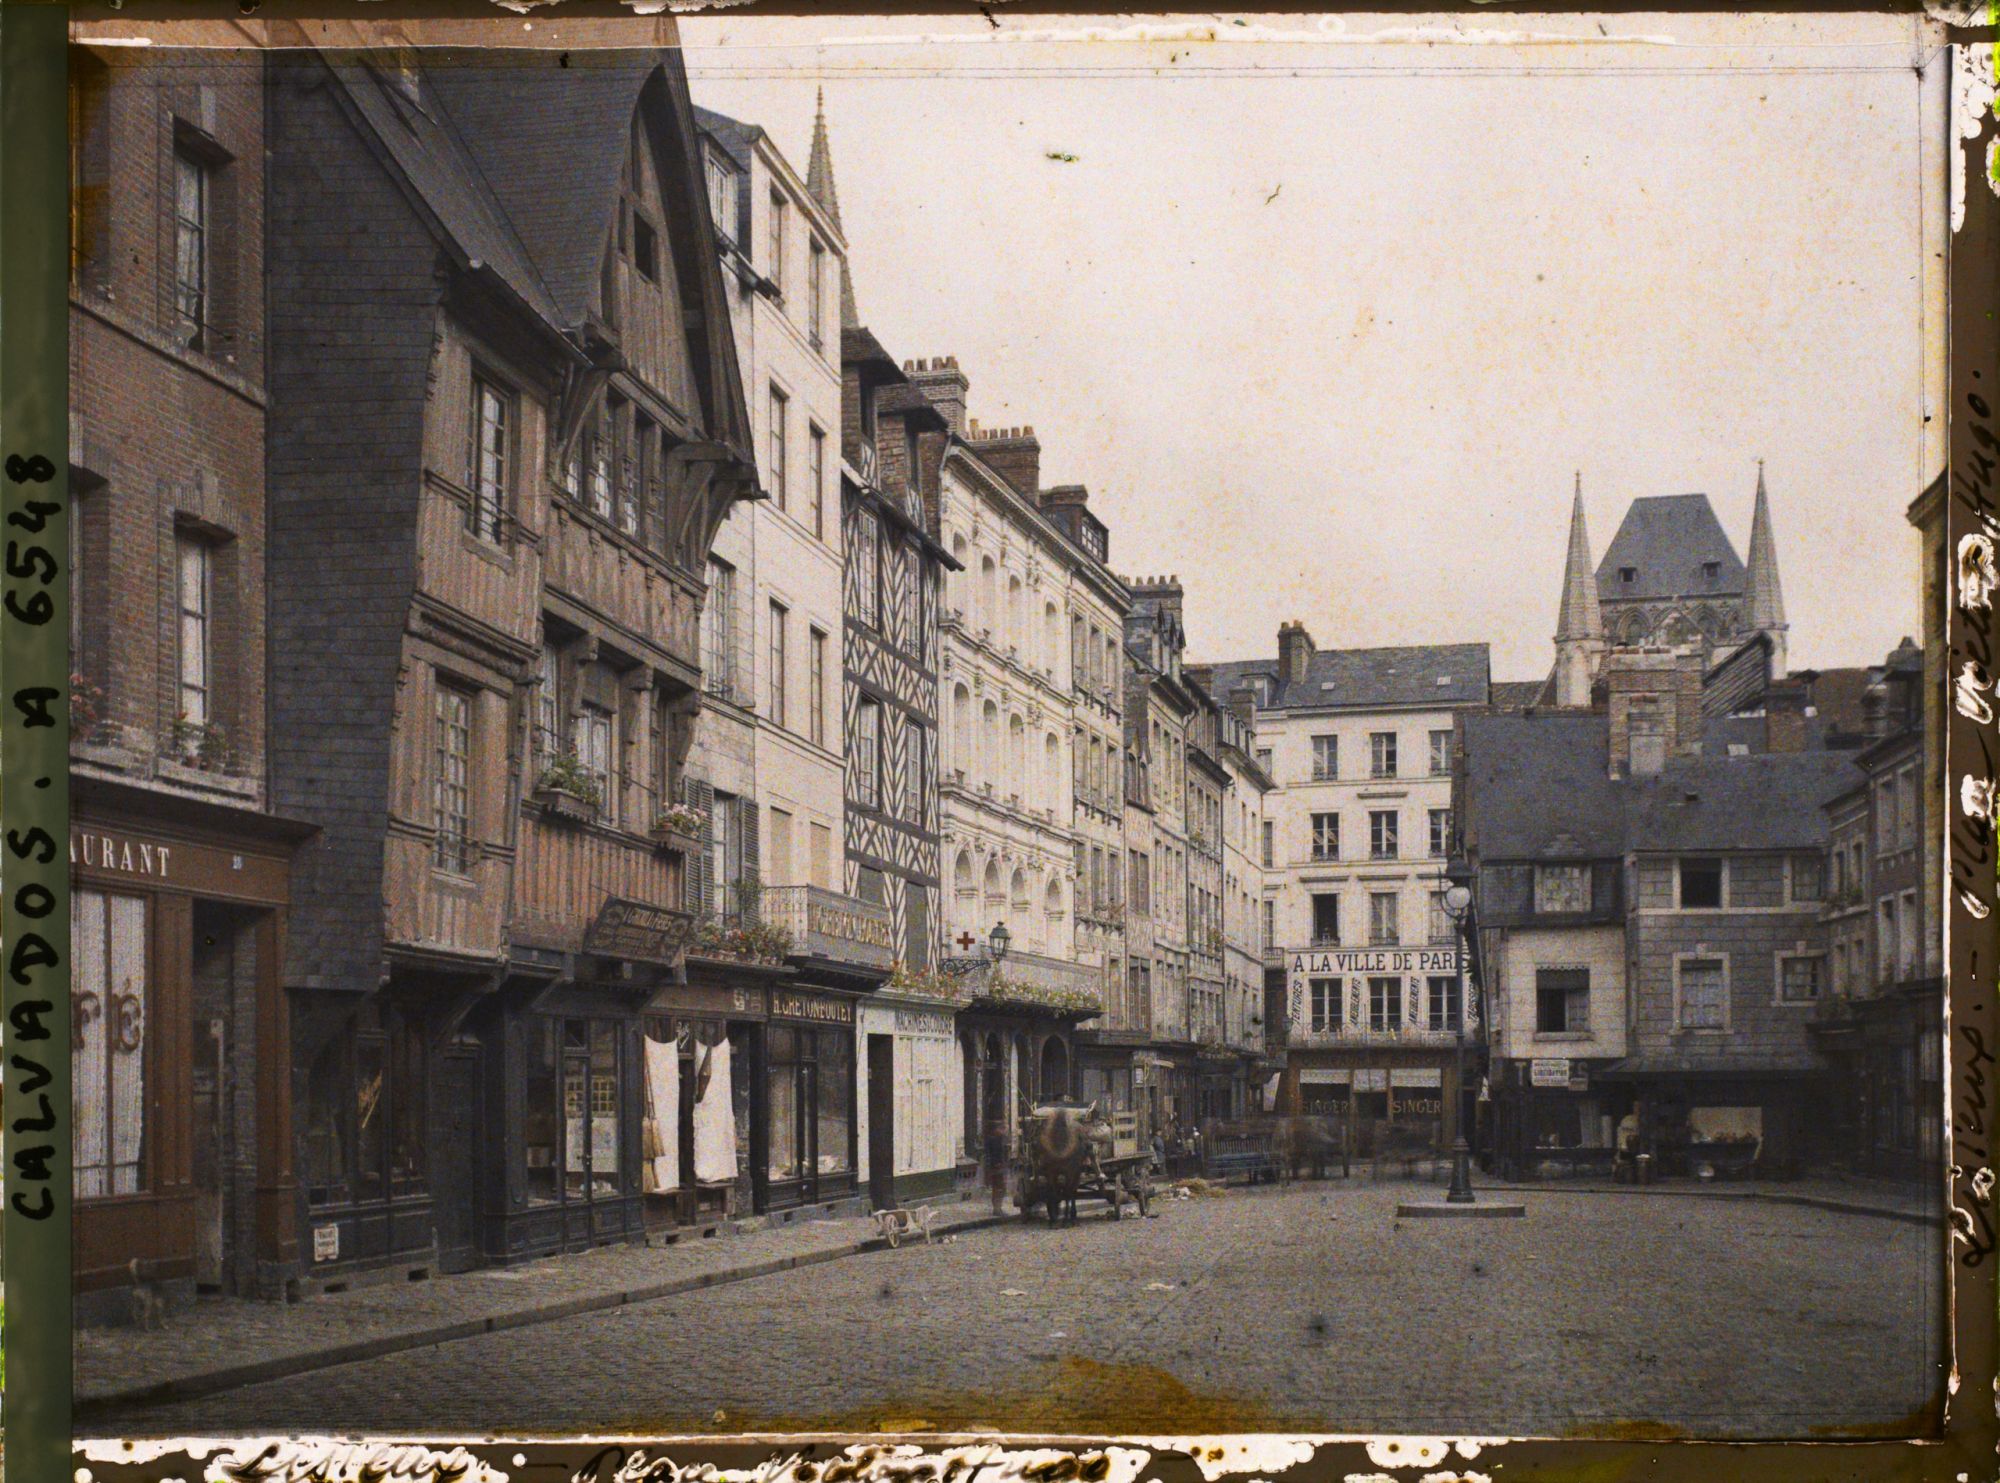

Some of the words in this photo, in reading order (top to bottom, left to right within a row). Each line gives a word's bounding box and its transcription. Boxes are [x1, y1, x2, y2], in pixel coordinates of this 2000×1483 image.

[5, 453, 62, 626] 6548
[13, 686, 60, 728] A
[1293, 954, 1304, 973] A
[1310, 953, 1332, 972] LA
[1336, 952, 1386, 972] VILLE
[1392, 952, 1413, 971] DE
[1291, 979, 1302, 1024] TENTURES
[1302, 1100, 1350, 1114] SINGER
[1392, 1099, 1442, 1114] SINGER
